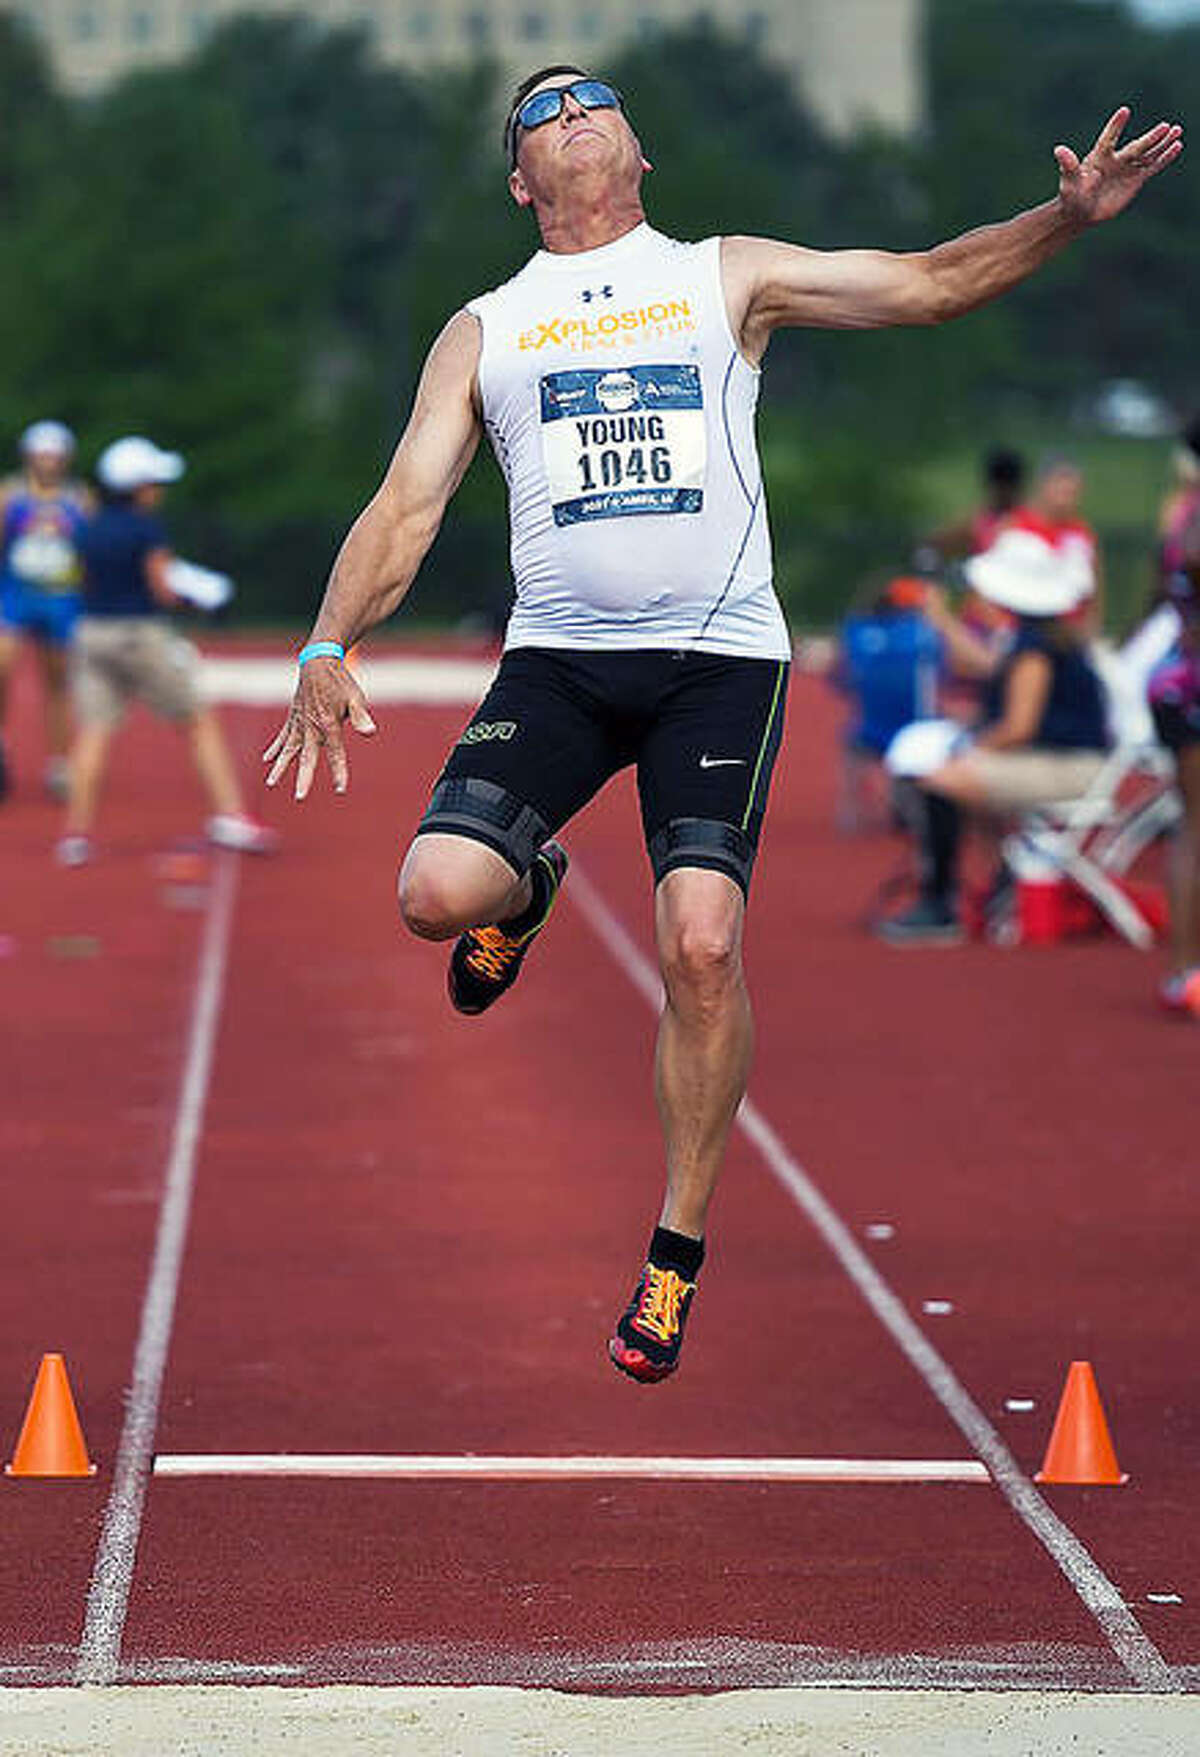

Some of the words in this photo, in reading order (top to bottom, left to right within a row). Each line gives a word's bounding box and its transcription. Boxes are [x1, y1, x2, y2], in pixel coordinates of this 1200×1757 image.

[518, 299, 691, 351] EXPLOSION
[576, 415, 664, 448] YOUNG
[579, 447, 671, 491] 1046
